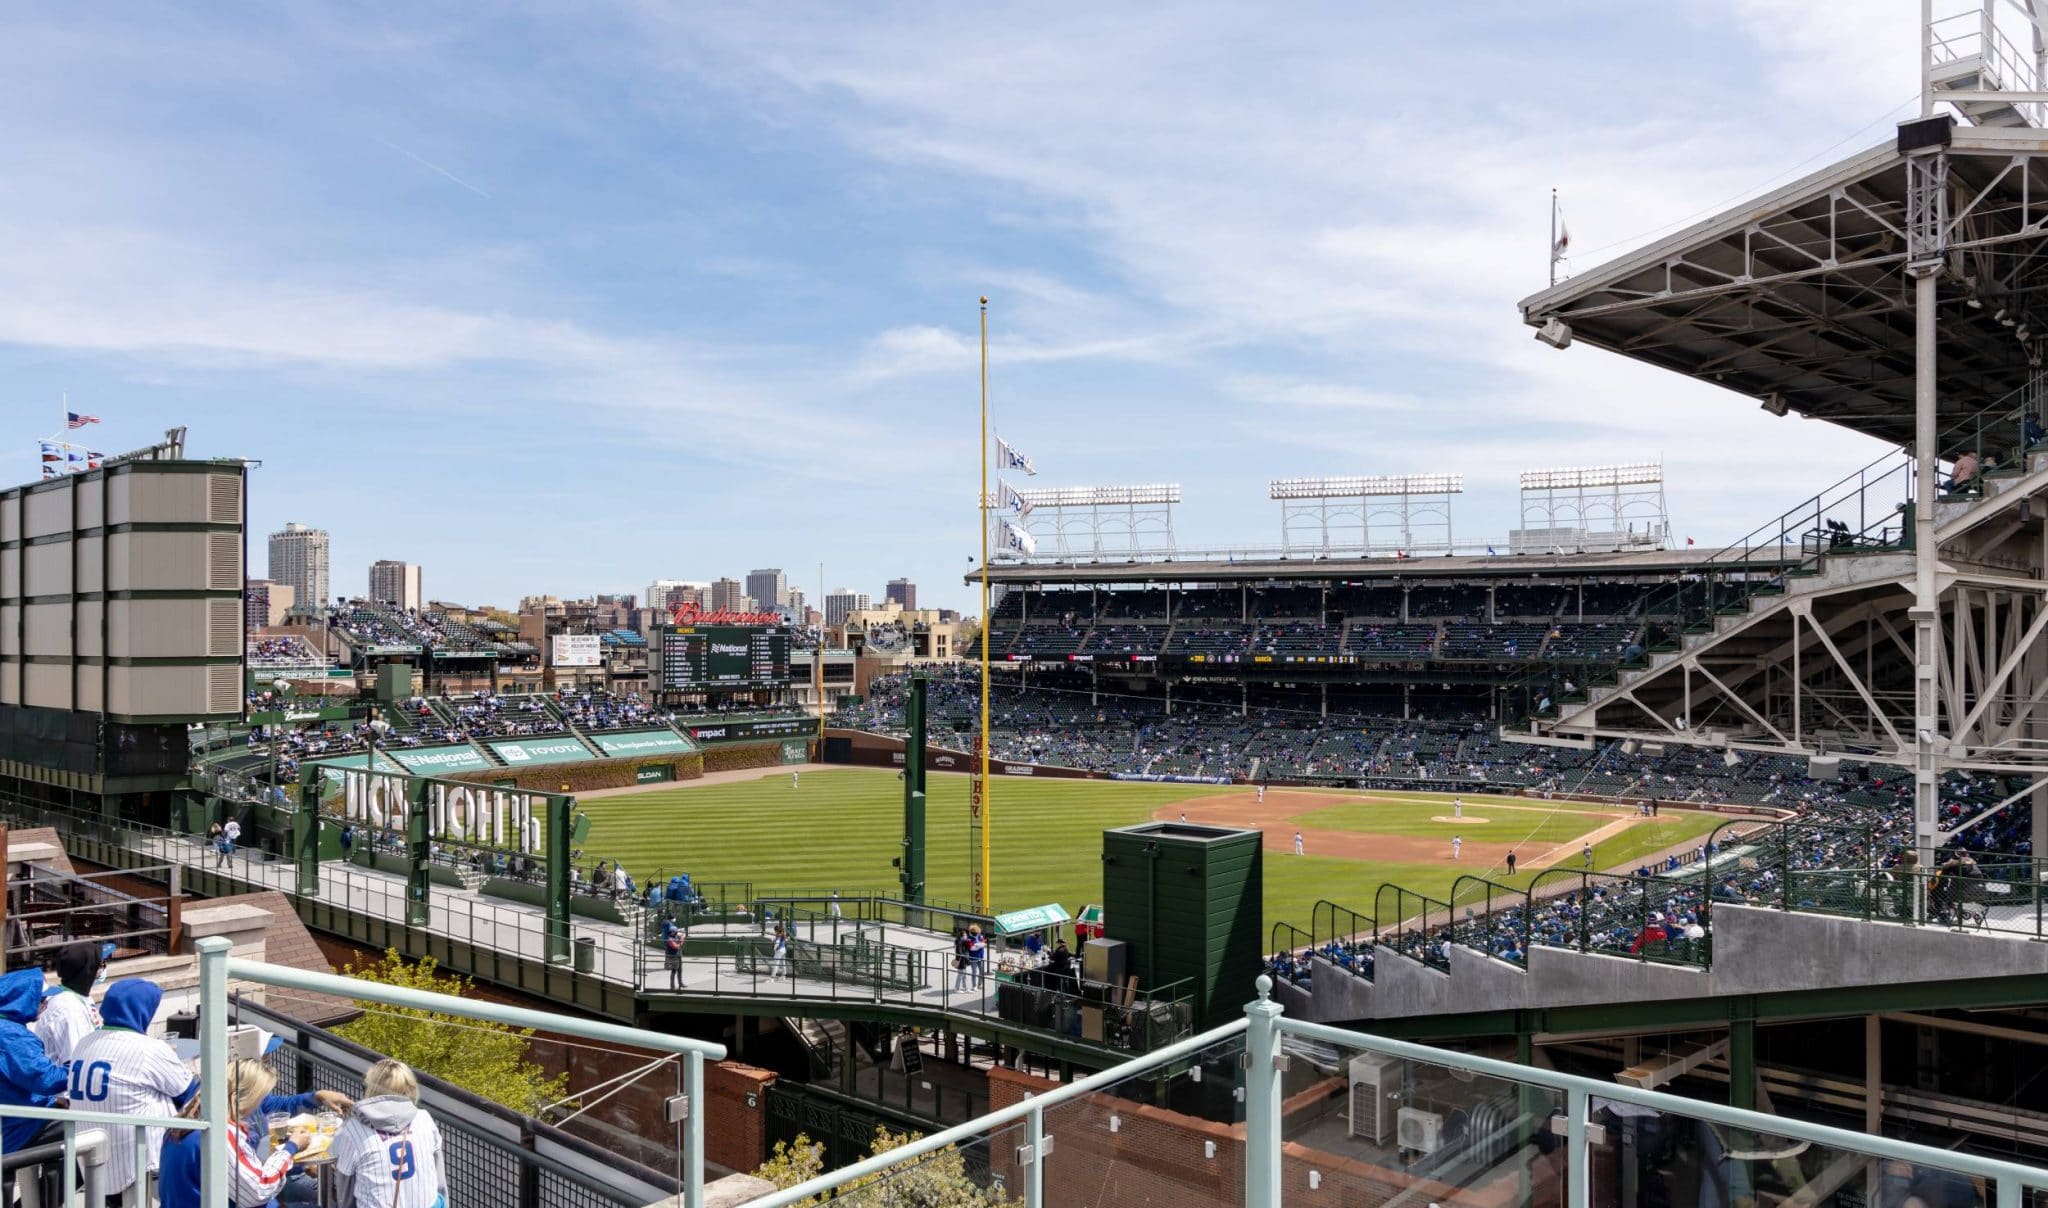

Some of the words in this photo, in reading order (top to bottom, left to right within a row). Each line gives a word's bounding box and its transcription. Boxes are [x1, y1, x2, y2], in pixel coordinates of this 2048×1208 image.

[668, 601, 782, 626] Budweiser
[719, 644, 748, 653] National
[696, 728, 726, 739] impact
[528, 743, 582, 757] TOYOTA
[417, 750, 480, 765] National
[637, 771, 662, 780] SLOAN
[70, 1059, 113, 1102] 10
[748, 1097, 756, 1107] 6
[388, 1140, 416, 1181] 9
